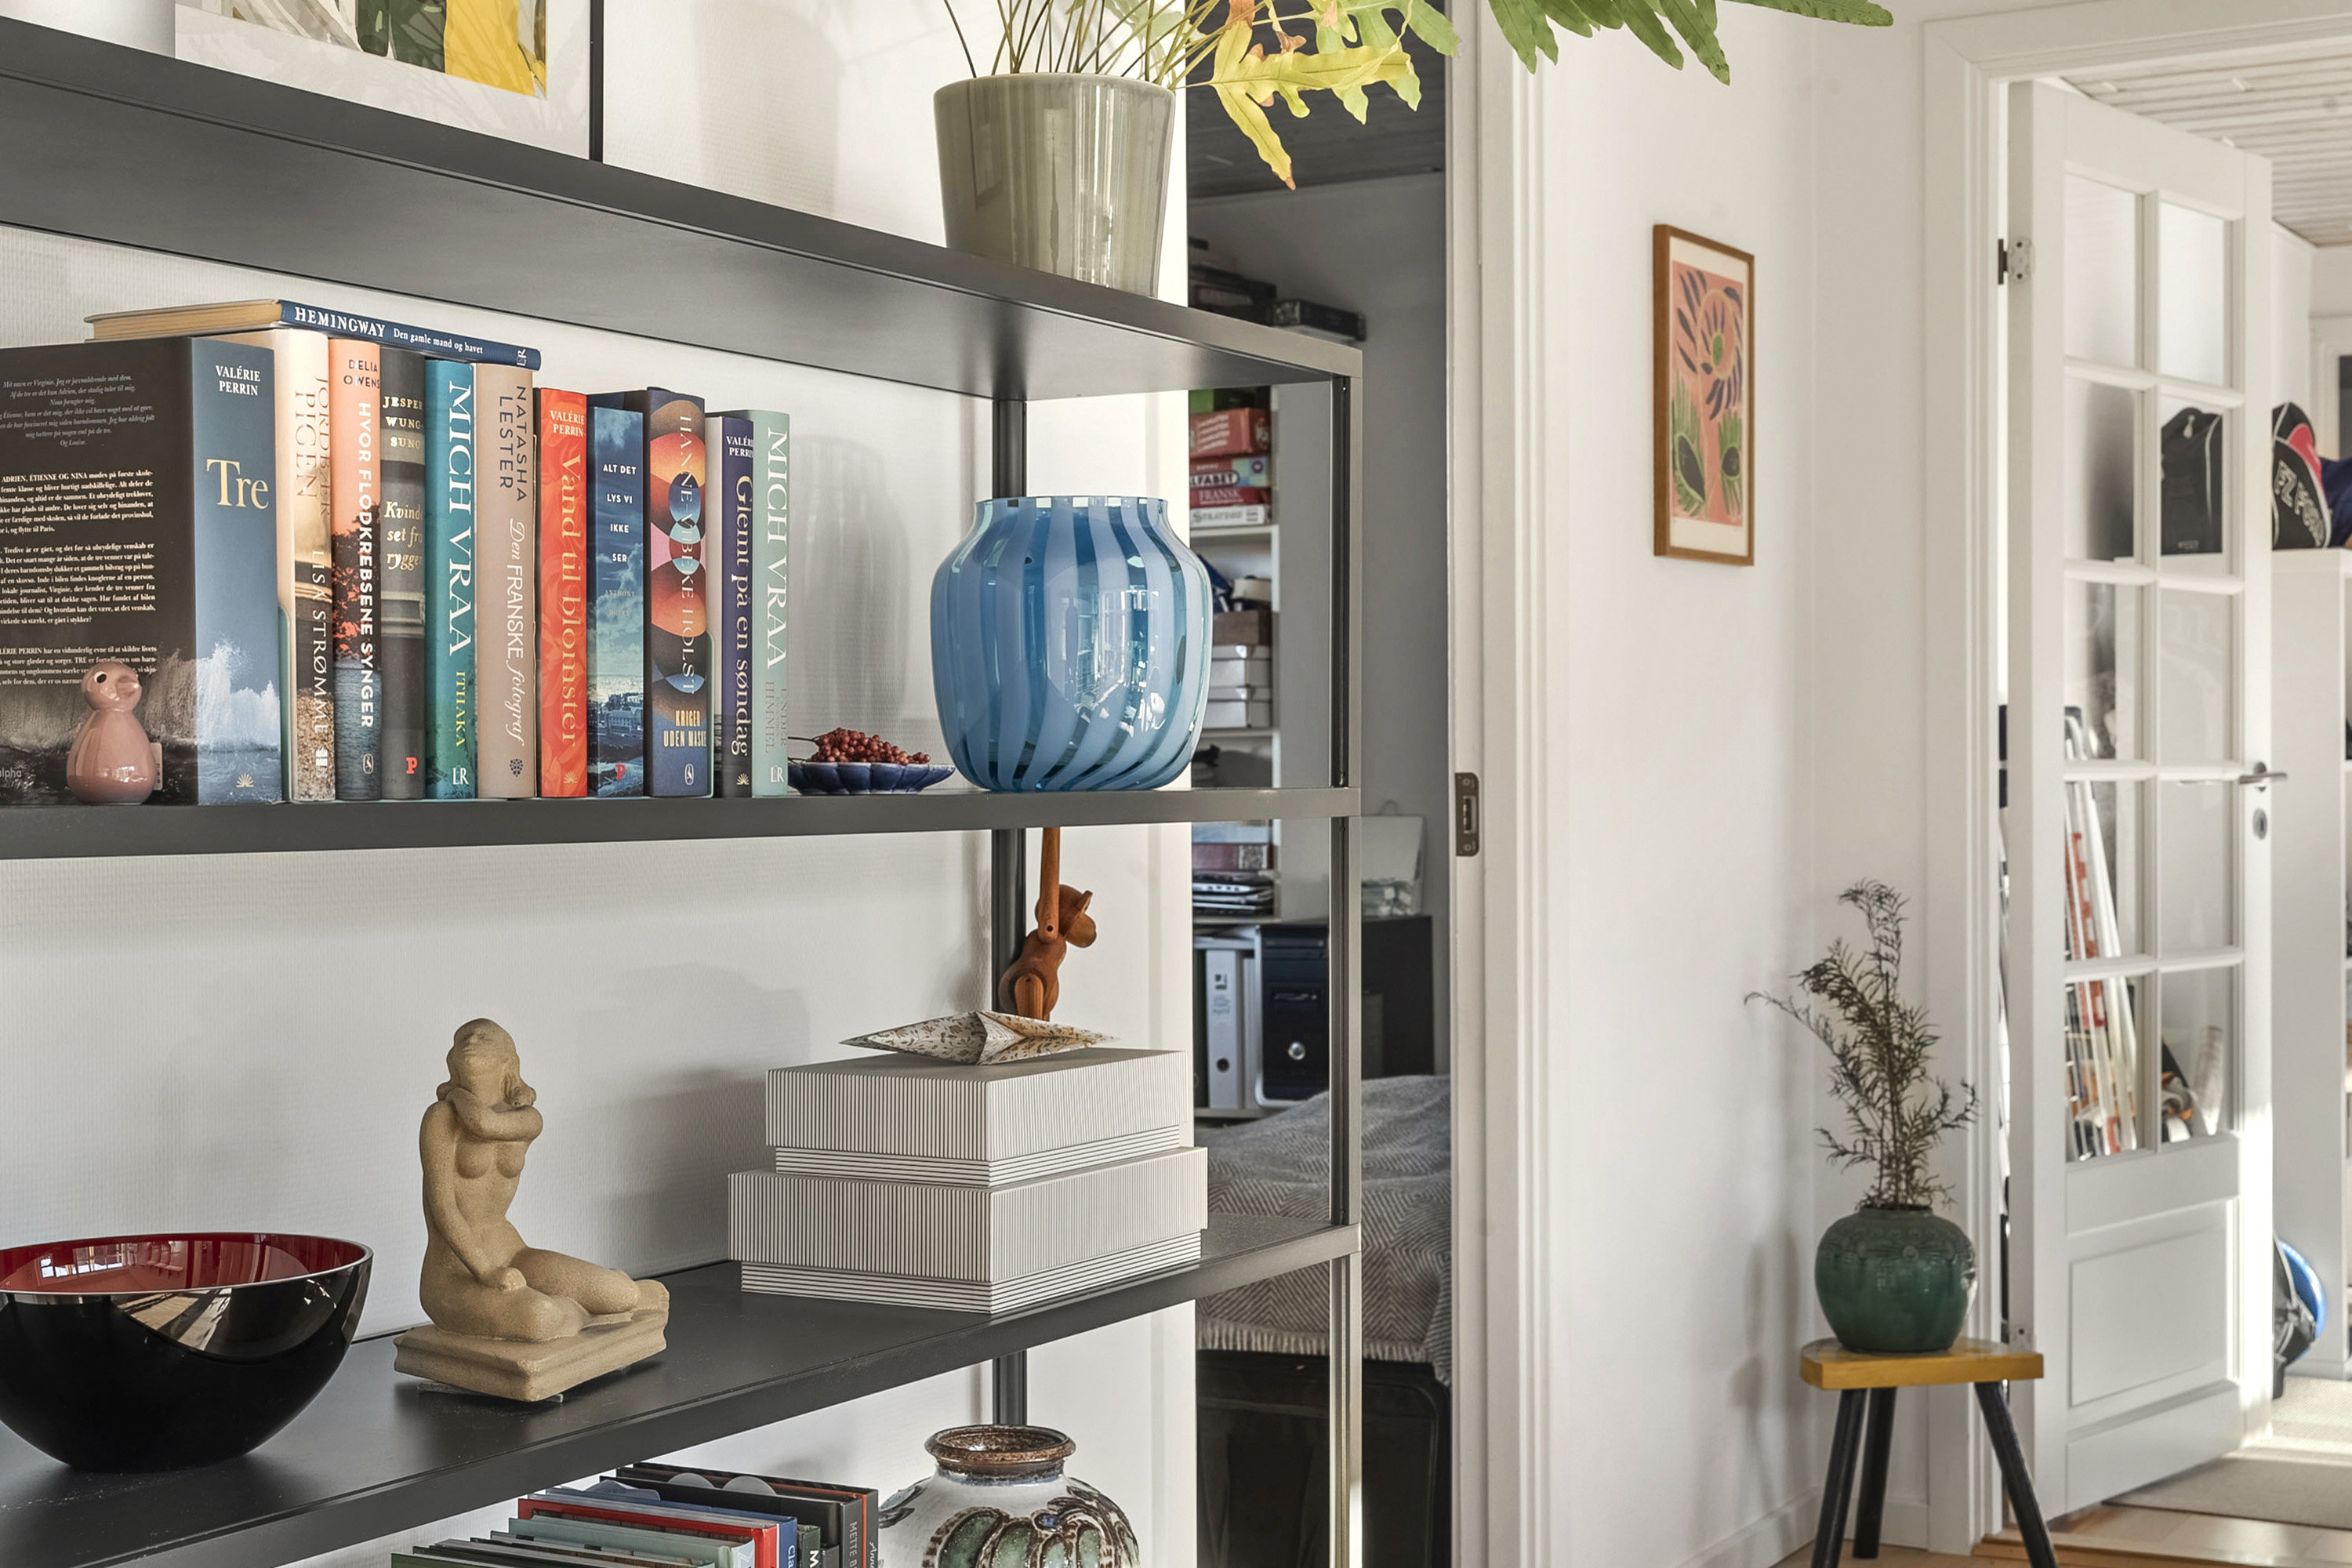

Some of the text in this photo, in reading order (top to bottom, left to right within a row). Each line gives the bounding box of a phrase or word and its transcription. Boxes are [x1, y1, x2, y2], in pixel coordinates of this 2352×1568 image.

[295, 307, 483, 354] HEMINGWAY Den gamle mand og havet
[215, 365, 261, 383] VALÉRIE
[348, 359, 379, 373] DELIA
[218, 380, 260, 396] PERRIN
[343, 374, 380, 389] OWENS
[550, 409, 585, 425] VALÉRIE
[553, 423, 584, 437] PERRIN
[499, 396, 514, 488] LESTER
[516, 386, 528, 502] NATASHA
[603, 463, 637, 475] ALT DET
[206, 459, 270, 510] Tre
[607, 493, 633, 504] LYS VI
[449, 380, 472, 656] MICH VRAA
[387, 528, 407, 543] set
[609, 524, 630, 534] IKKE
[767, 426, 788, 669] MICH VRAA
[358, 402, 374, 728] HVOR FLODKREBSENE SYNGER
[612, 553, 628, 562] SER
[561, 454, 582, 747] Vand til blomster
[731, 475, 753, 756] Glemt på en søndag
[503, 517, 525, 746] Den FRANSKE fotograf
[312, 550, 328, 735] LISA STRØMME
[675, 710, 700, 728] KRIGER
[663, 730, 685, 747] UDEN
[405, 757, 419, 775] P
[615, 763, 626, 780] P
[770, 766, 785, 782] LR
[452, 767, 470, 786] LR
[849, 1521, 859, 1558] METTE
